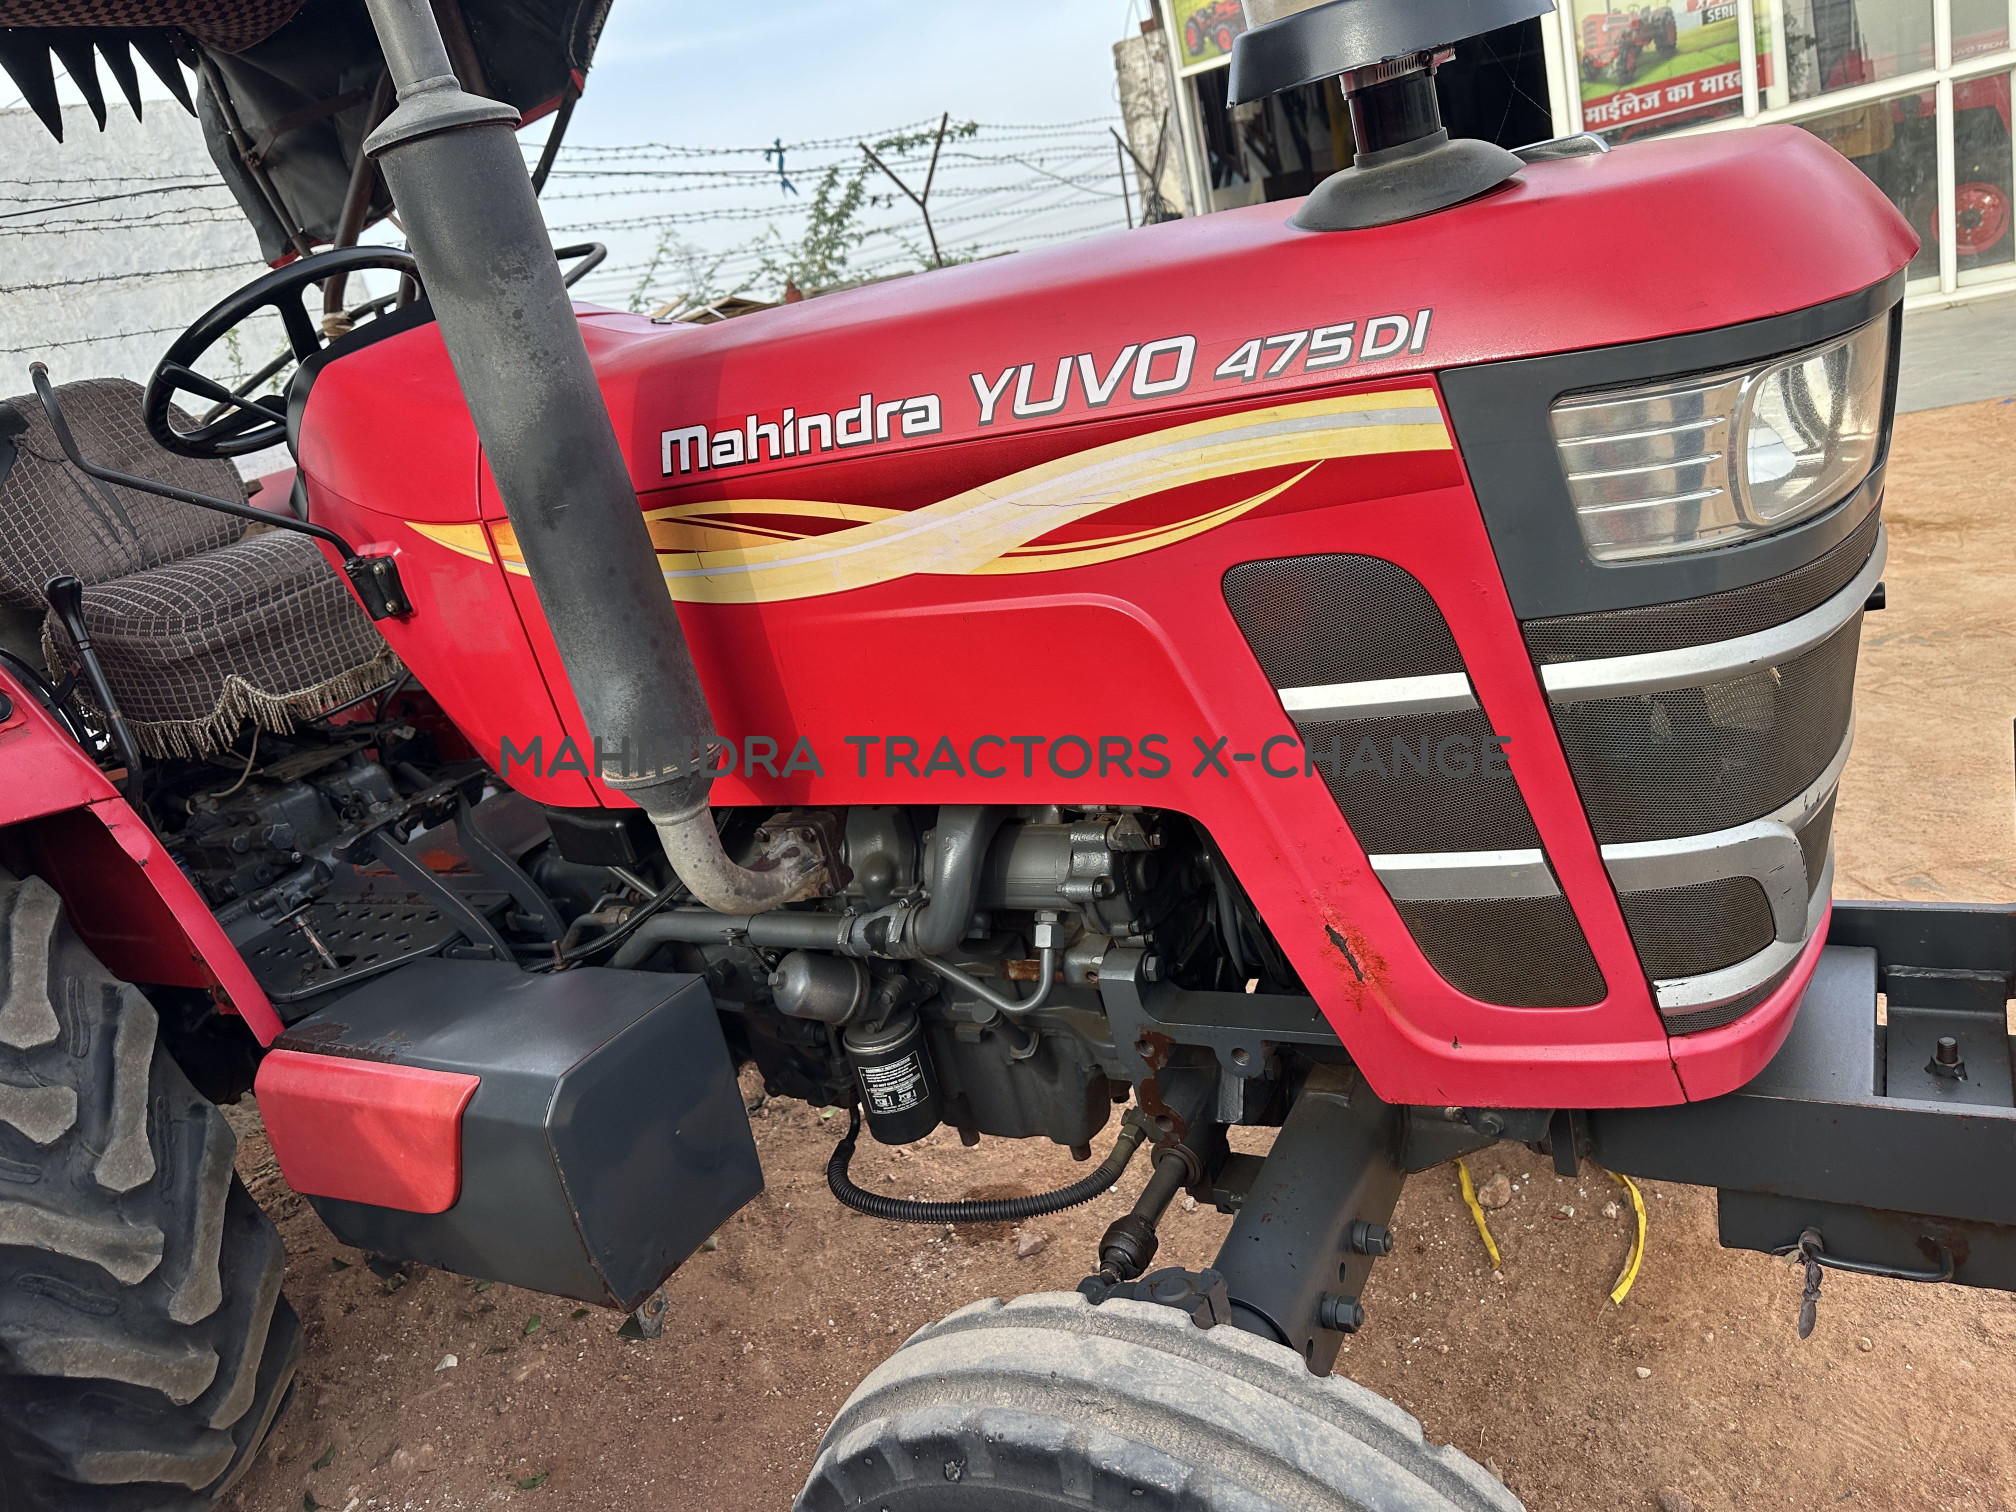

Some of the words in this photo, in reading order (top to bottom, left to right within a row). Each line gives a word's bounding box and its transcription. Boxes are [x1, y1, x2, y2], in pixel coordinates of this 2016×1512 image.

[1584, 92, 1661, 123] माईलेज
[1665, 81, 1695, 103] का
[1699, 69, 1742, 93] मास्
[660, 392, 942, 477] Mahindra
[969, 334, 1198, 426] YUVO
[1213, 321, 1357, 383] 475
[1357, 308, 1433, 363] DI
